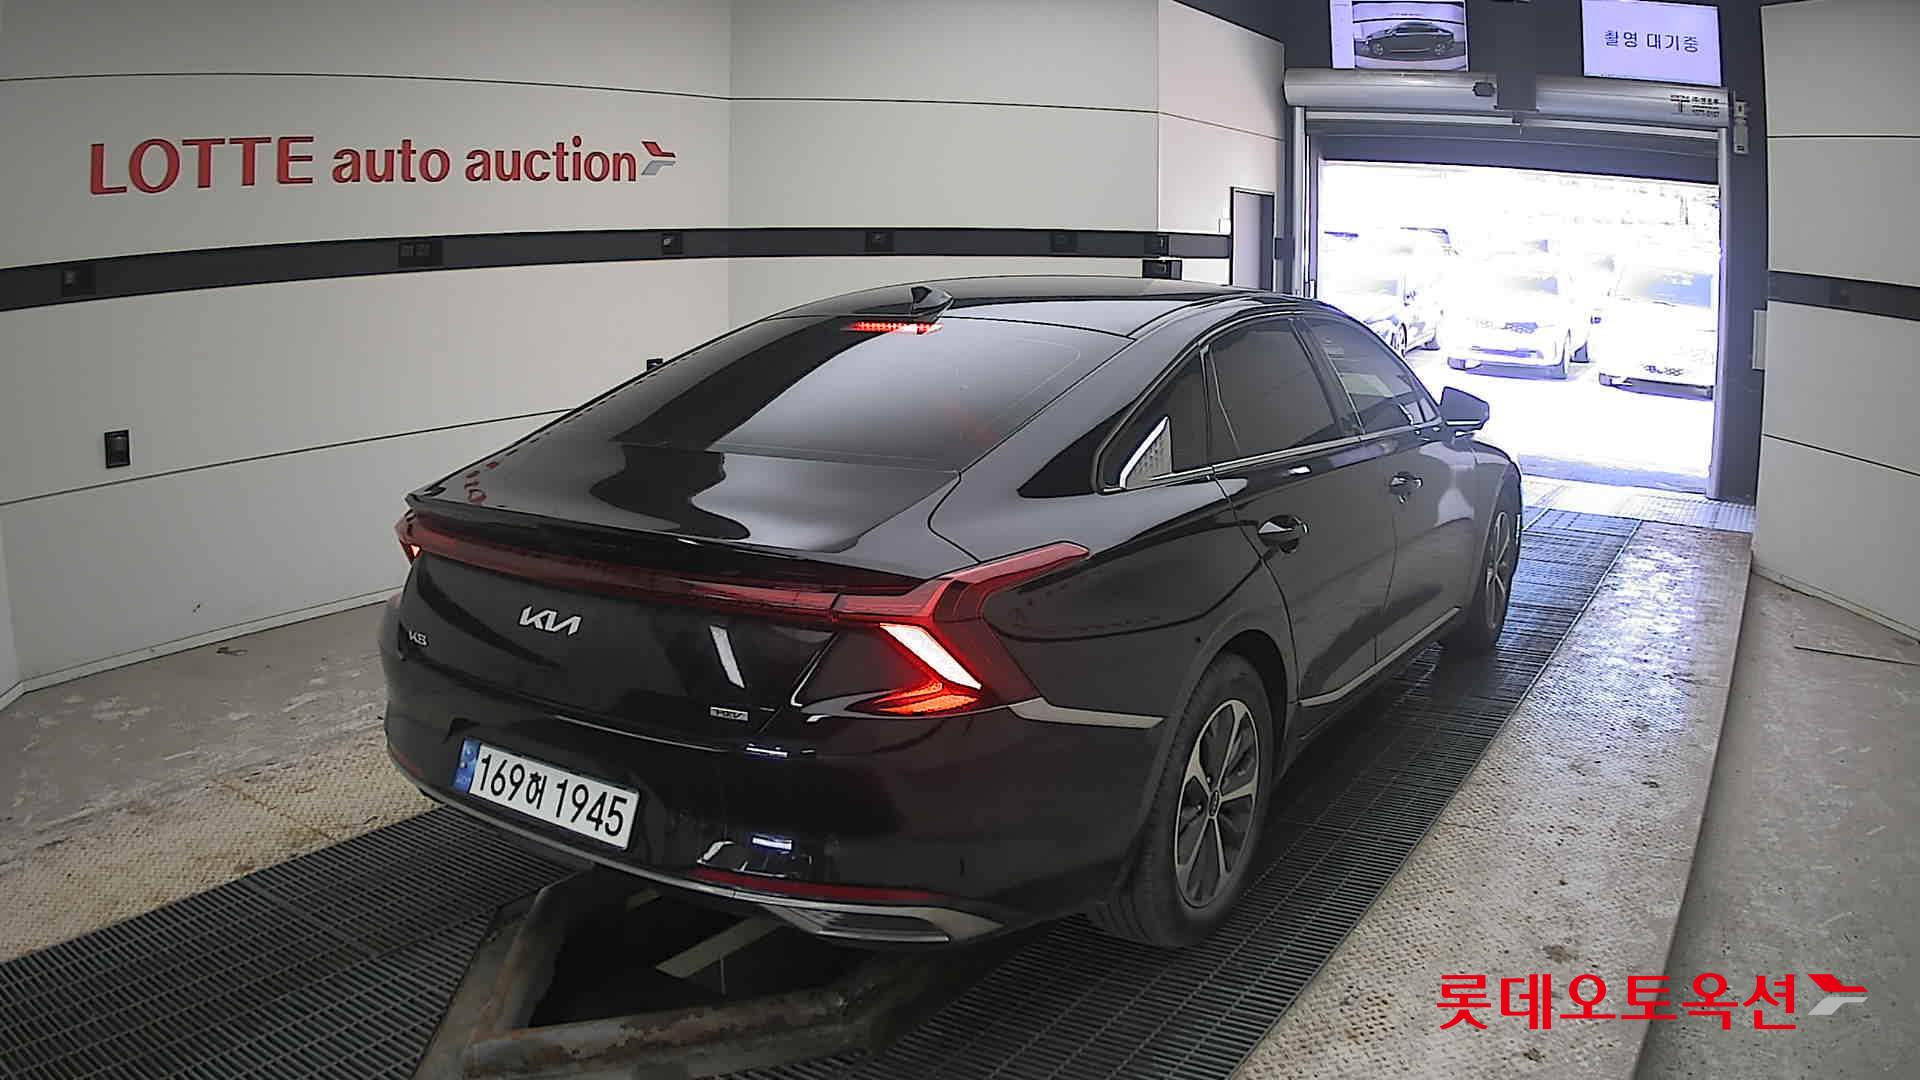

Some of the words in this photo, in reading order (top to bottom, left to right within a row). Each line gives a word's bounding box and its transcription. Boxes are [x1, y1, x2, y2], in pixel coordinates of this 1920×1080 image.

[1604, 30, 1638, 48] 촬영
[1646, 33, 1699, 52] 대기중
[90, 136, 314, 195] LOTTE
[332, 139, 450, 183] auto
[465, 135, 637, 182] auction
[519, 605, 582, 636] KIA
[481, 754, 548, 810] 169허
[556, 779, 629, 837] 1945
